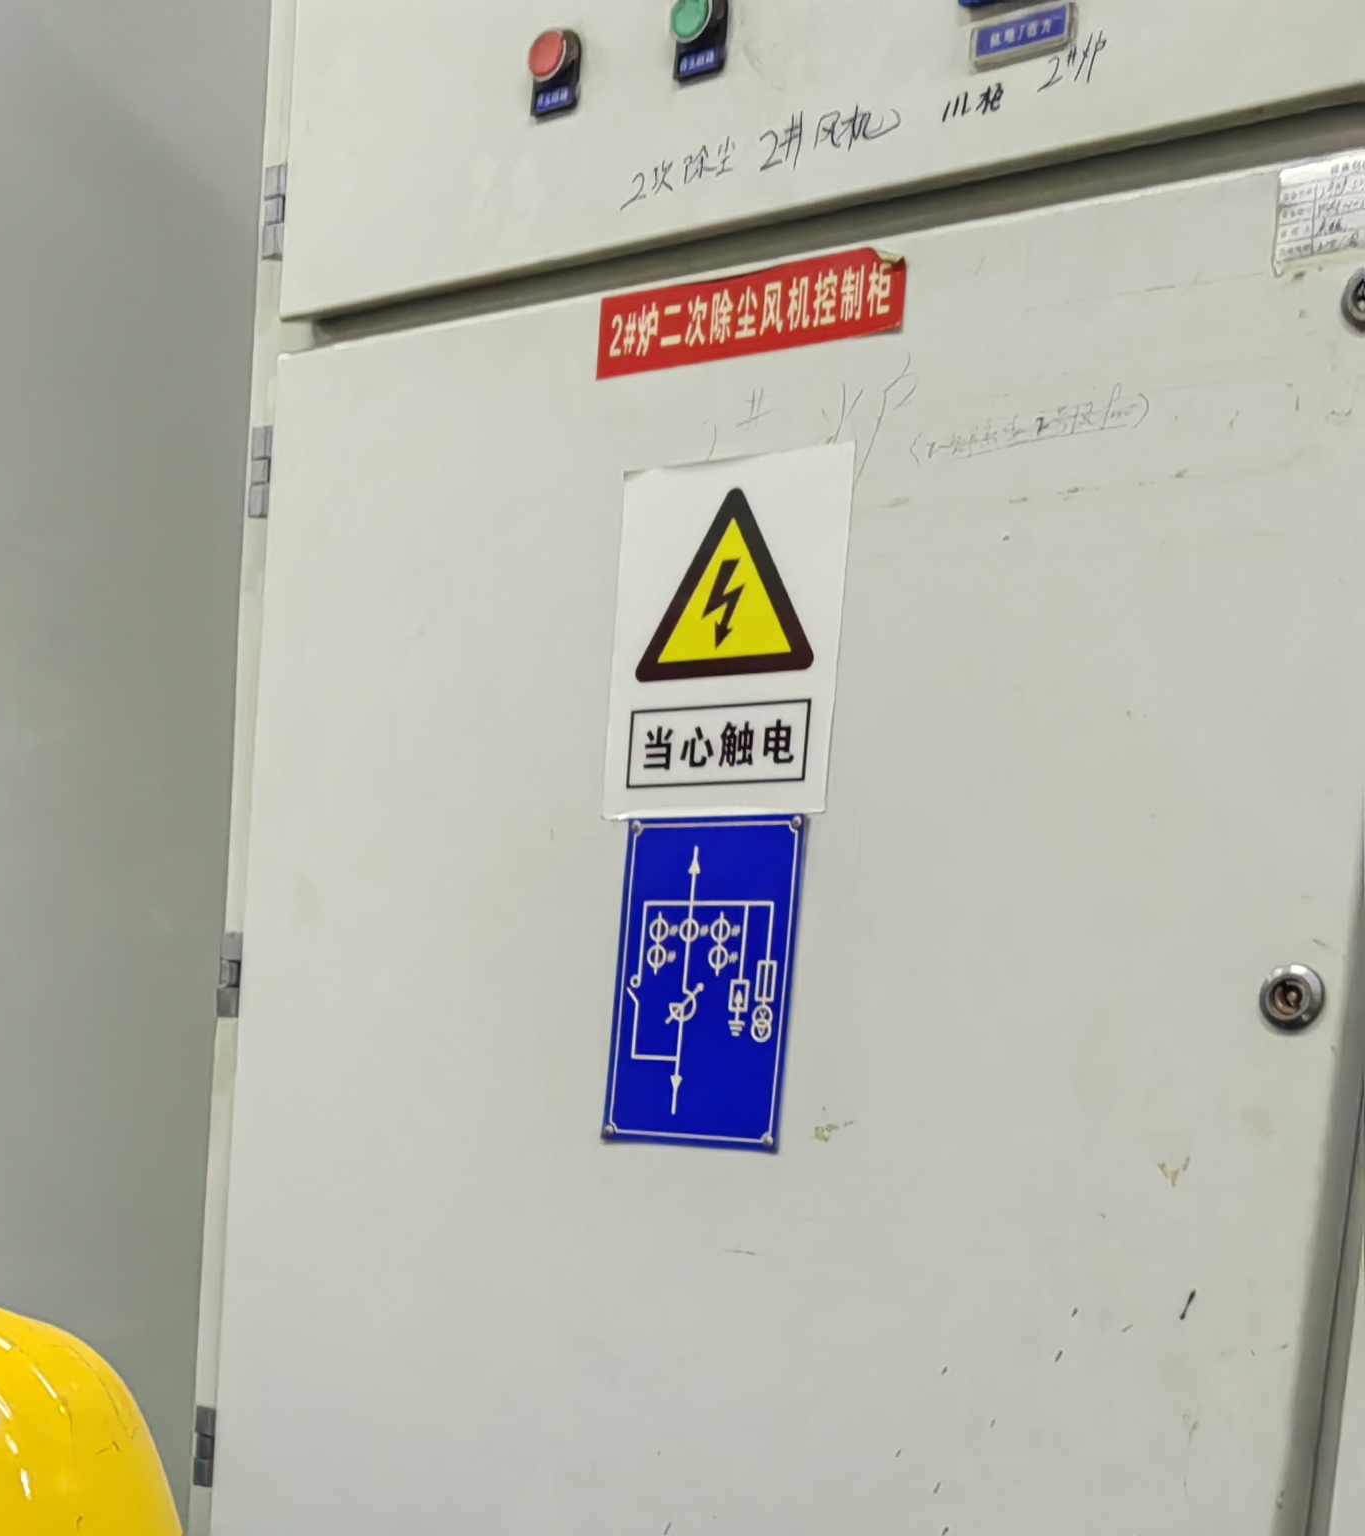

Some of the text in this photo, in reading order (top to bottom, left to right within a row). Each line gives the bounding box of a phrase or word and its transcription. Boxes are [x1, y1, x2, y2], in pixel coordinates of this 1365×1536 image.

[609, 261, 892, 358] 2#炉二次除尘风机控制柜
[641, 718, 796, 771] 当心触电
